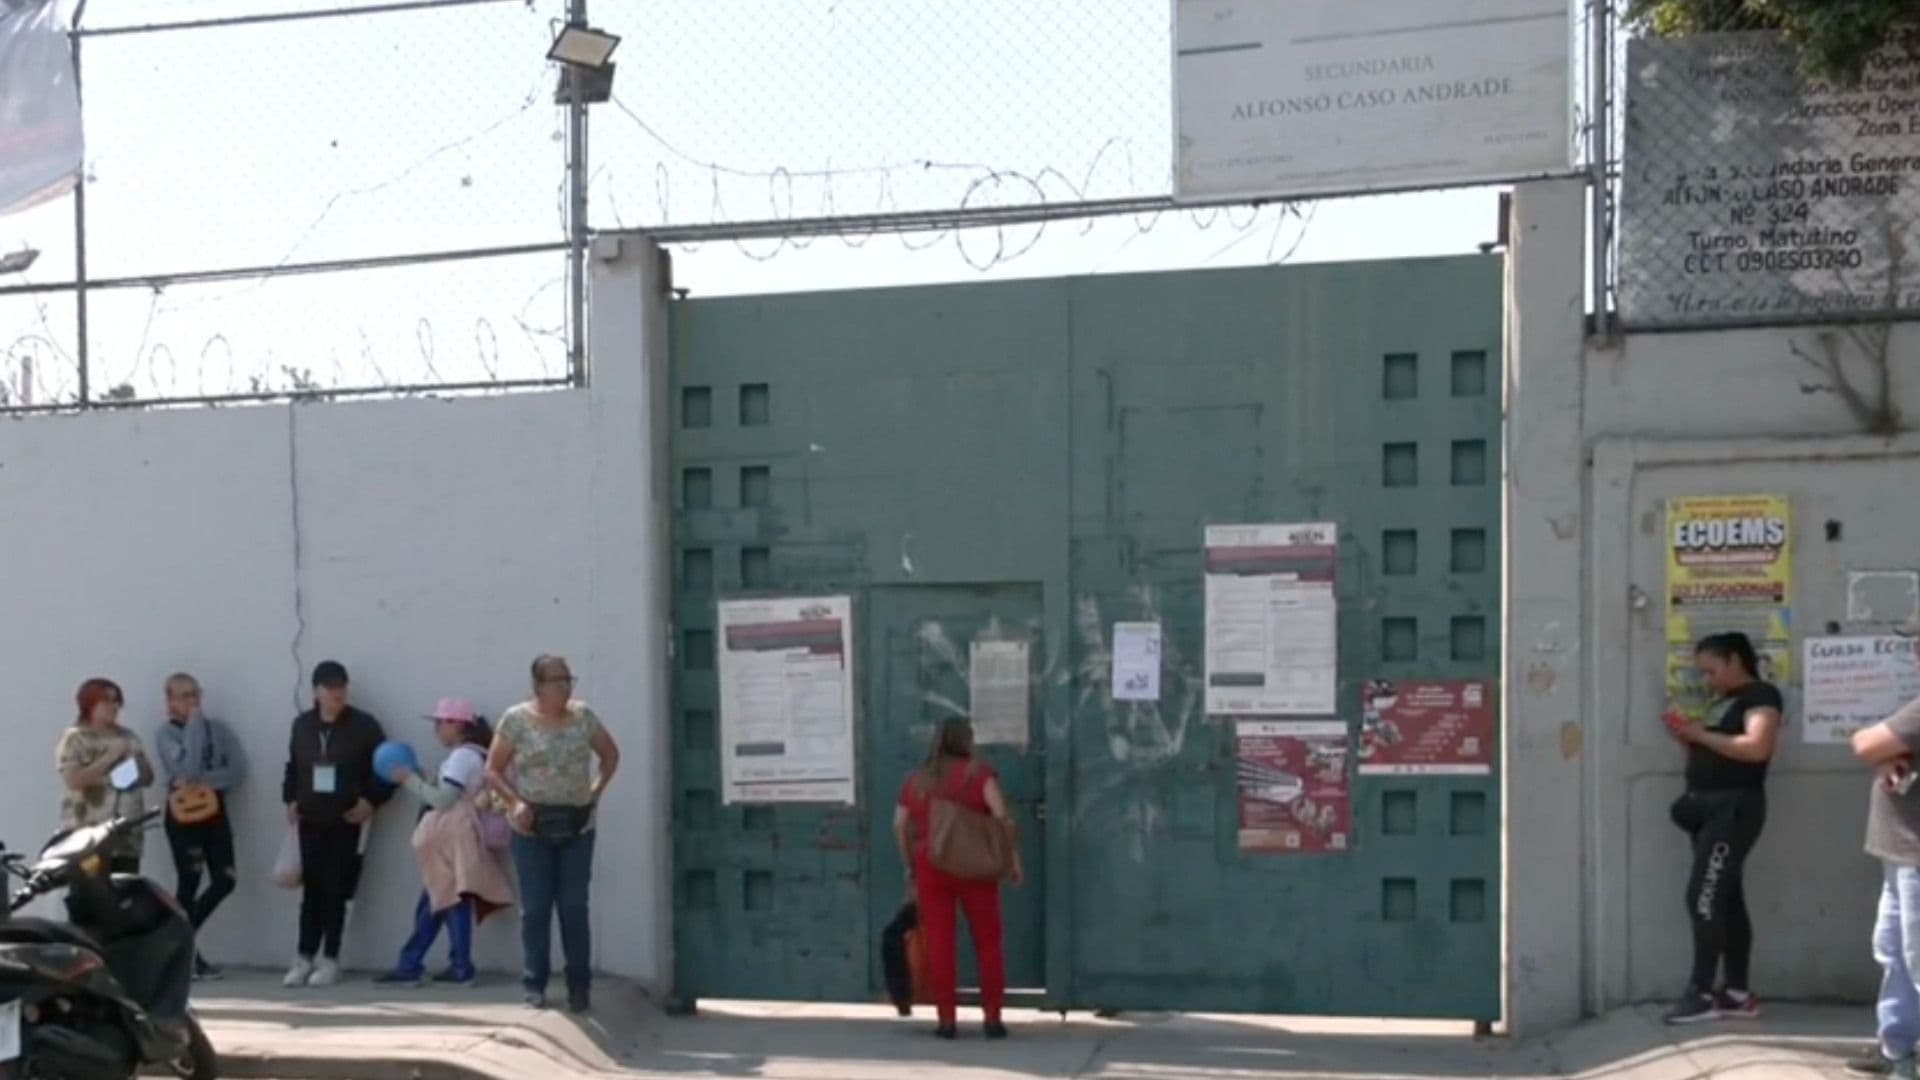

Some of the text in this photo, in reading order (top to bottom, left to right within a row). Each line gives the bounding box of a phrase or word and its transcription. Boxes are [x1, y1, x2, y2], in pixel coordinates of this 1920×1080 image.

[1305, 55, 1435, 82] SECUNDARIA
[1231, 76, 1514, 120] ALFONSO CASO ANDRADE
[1856, 117, 1901, 137] Zona
[1811, 174, 1900, 199] ANDRADE
[1768, 202, 1808, 224] 324
[1688, 225, 1858, 250] Turno Matutino
[1674, 516, 1784, 549] ECOEMS
